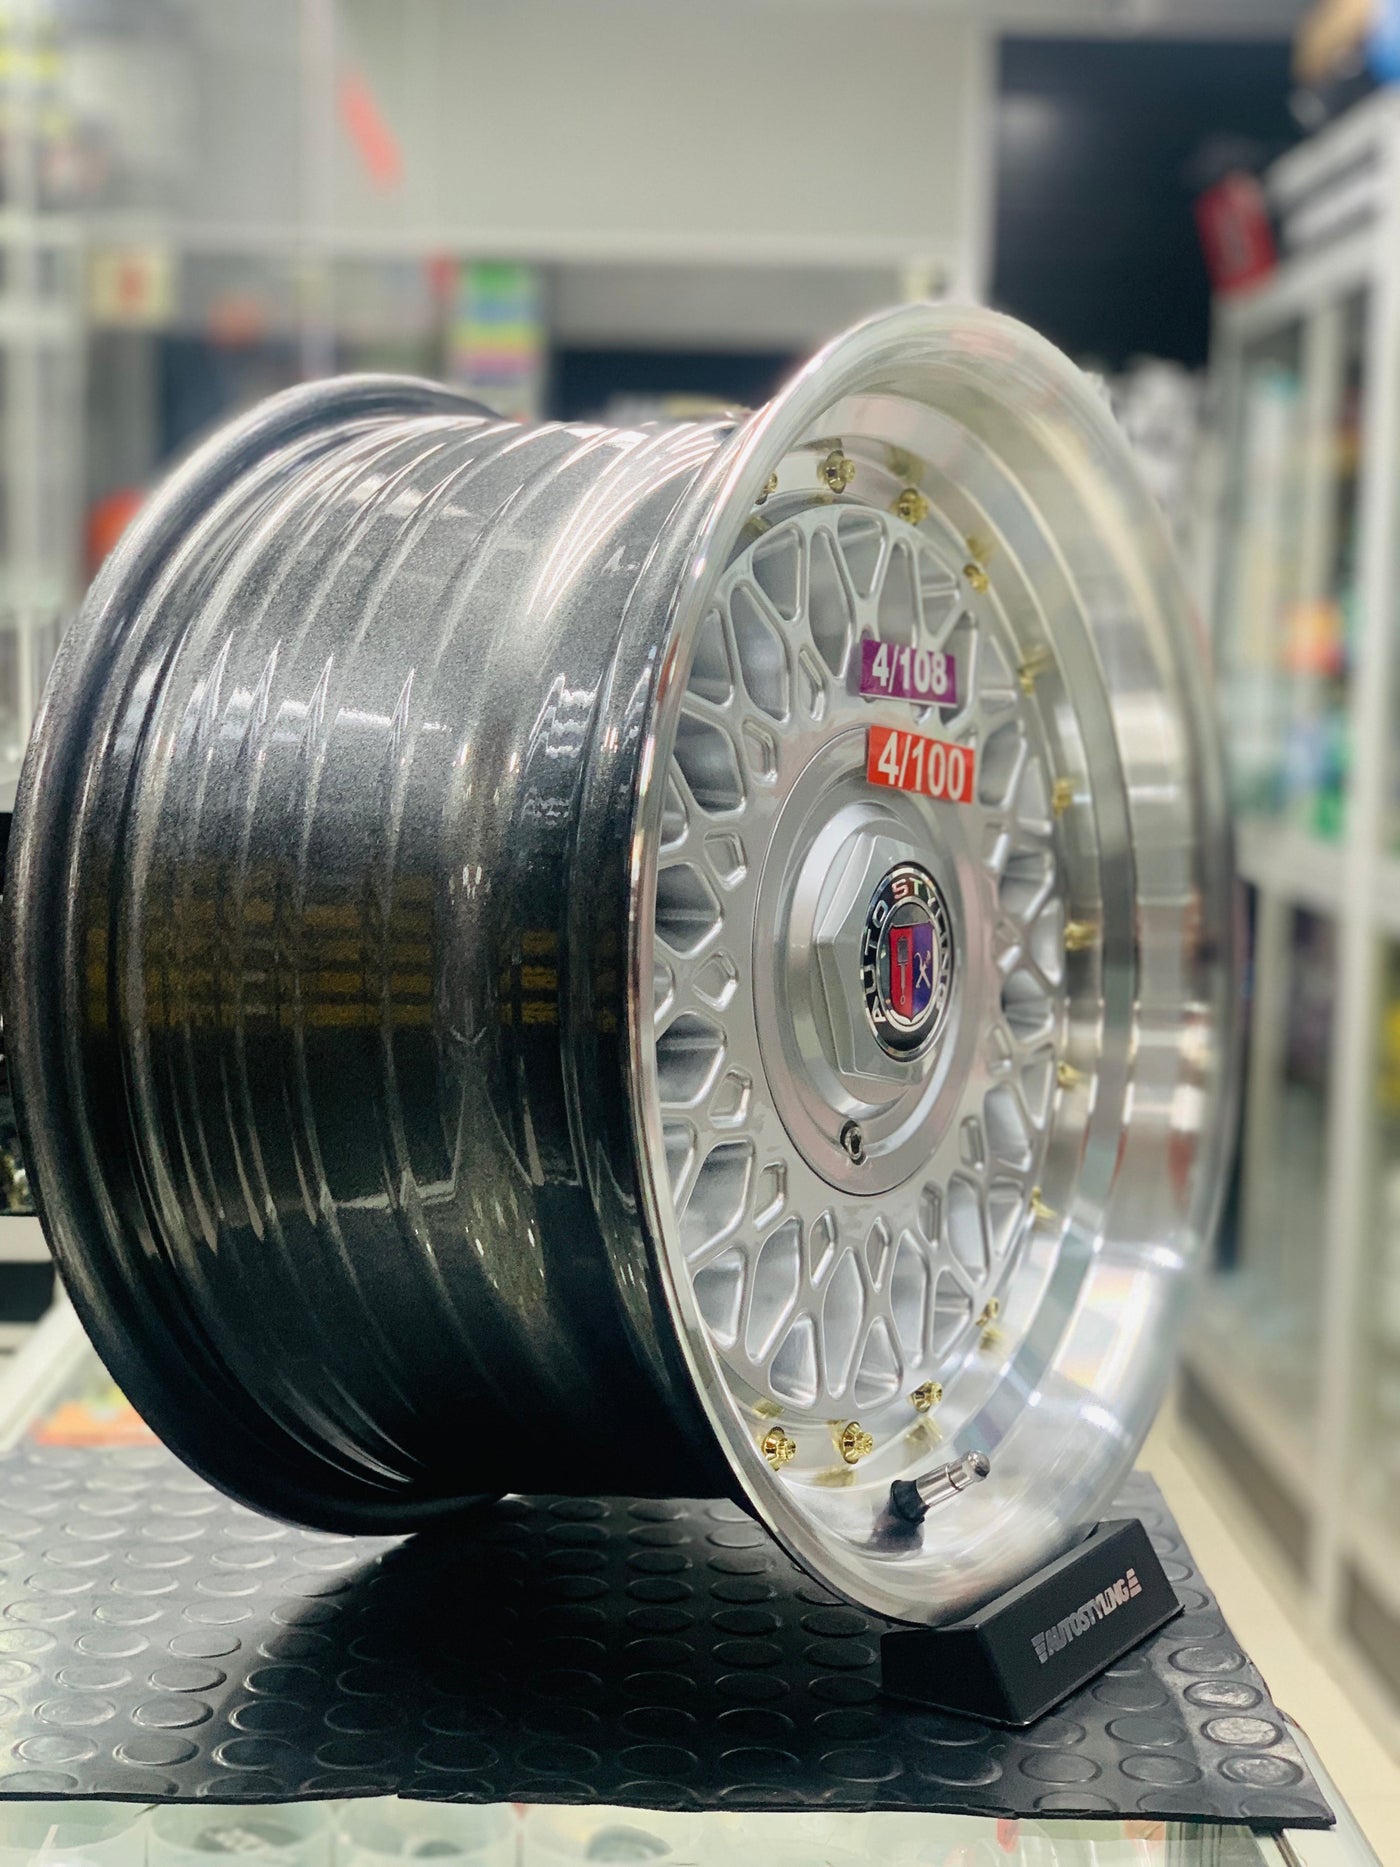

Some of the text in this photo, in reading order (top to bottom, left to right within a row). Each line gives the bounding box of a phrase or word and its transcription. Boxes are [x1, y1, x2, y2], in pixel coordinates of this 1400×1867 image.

[872, 643, 948, 695] 4/108
[878, 731, 966, 800] 4/100
[864, 900, 889, 1023] AUTO
